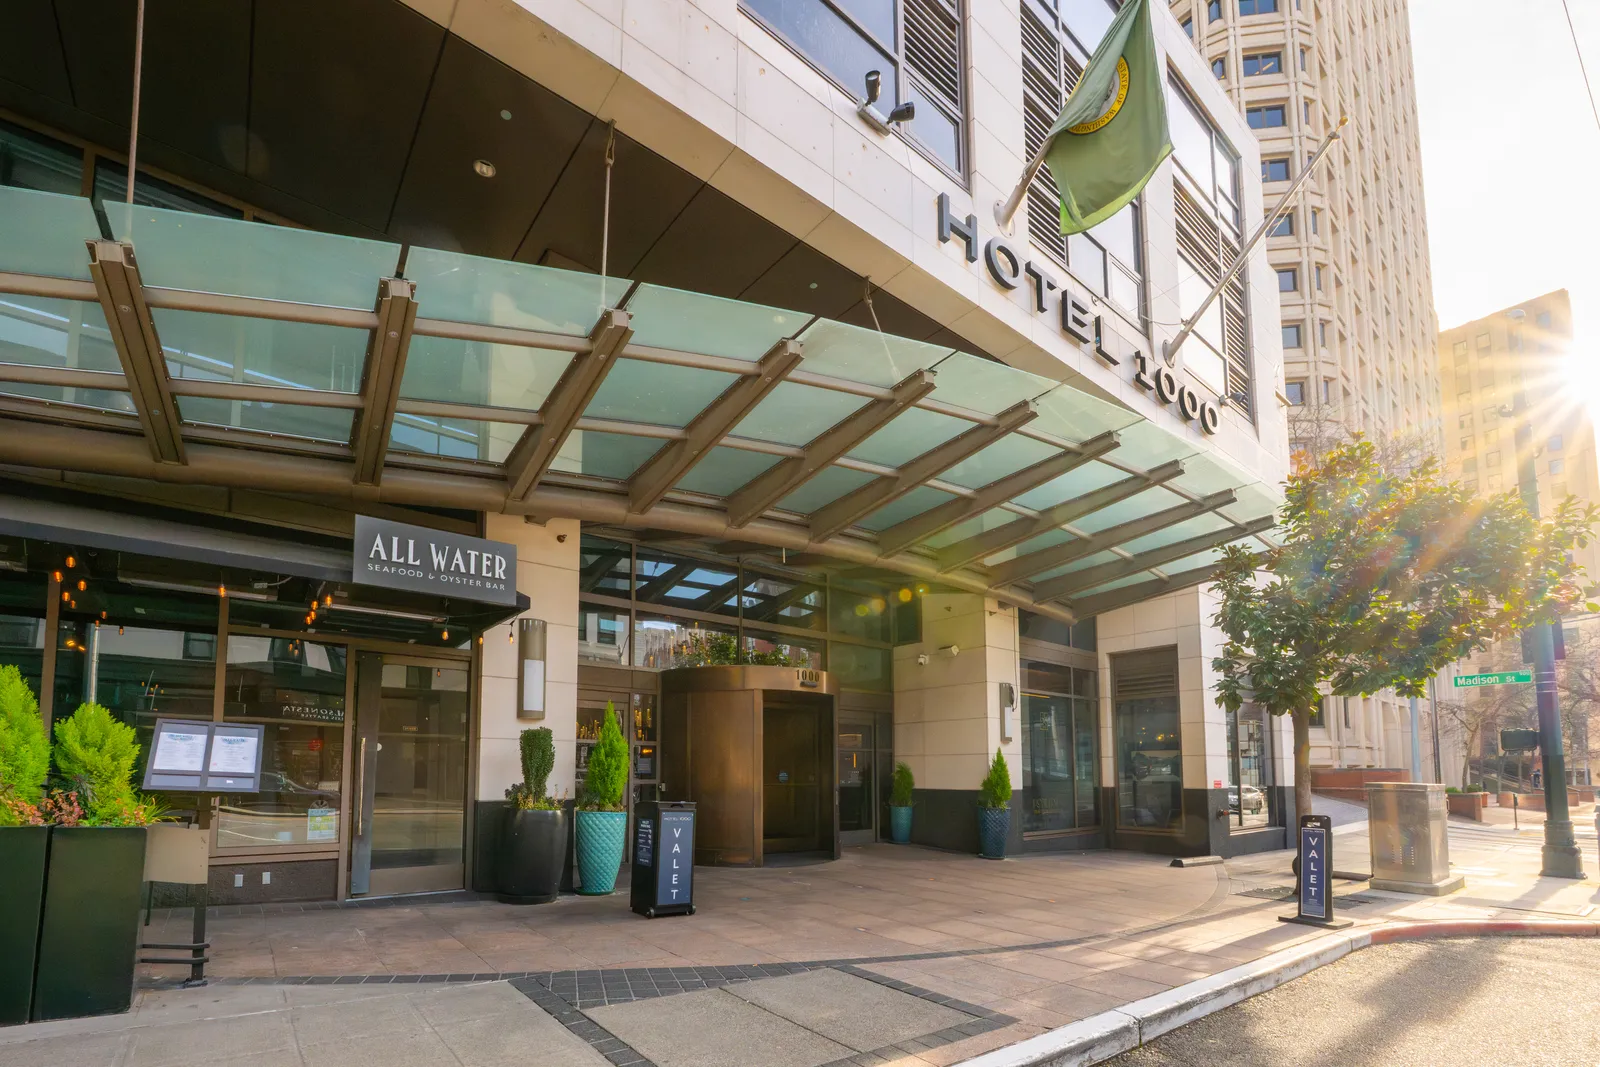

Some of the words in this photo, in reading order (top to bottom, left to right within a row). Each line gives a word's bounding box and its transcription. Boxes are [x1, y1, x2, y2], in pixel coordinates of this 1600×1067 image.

[1119, 63, 1128, 90] STATE
[1117, 94, 1125, 105] OF
[937, 191, 1120, 366] HOTEL
[1133, 350, 1221, 435] 1000
[369, 533, 421, 566] ALL
[429, 543, 507, 580] WATER
[367, 563, 423, 578] SEAFOOD
[440, 574, 482, 588] OYSTER
[485, 582, 505, 591] BAR
[795, 669, 820, 682] 1000
[1457, 675, 1499, 686] Madison
[1505, 675, 1516, 683] St
[671, 827, 682, 900] VALET
[1308, 836, 1319, 897] VALET
